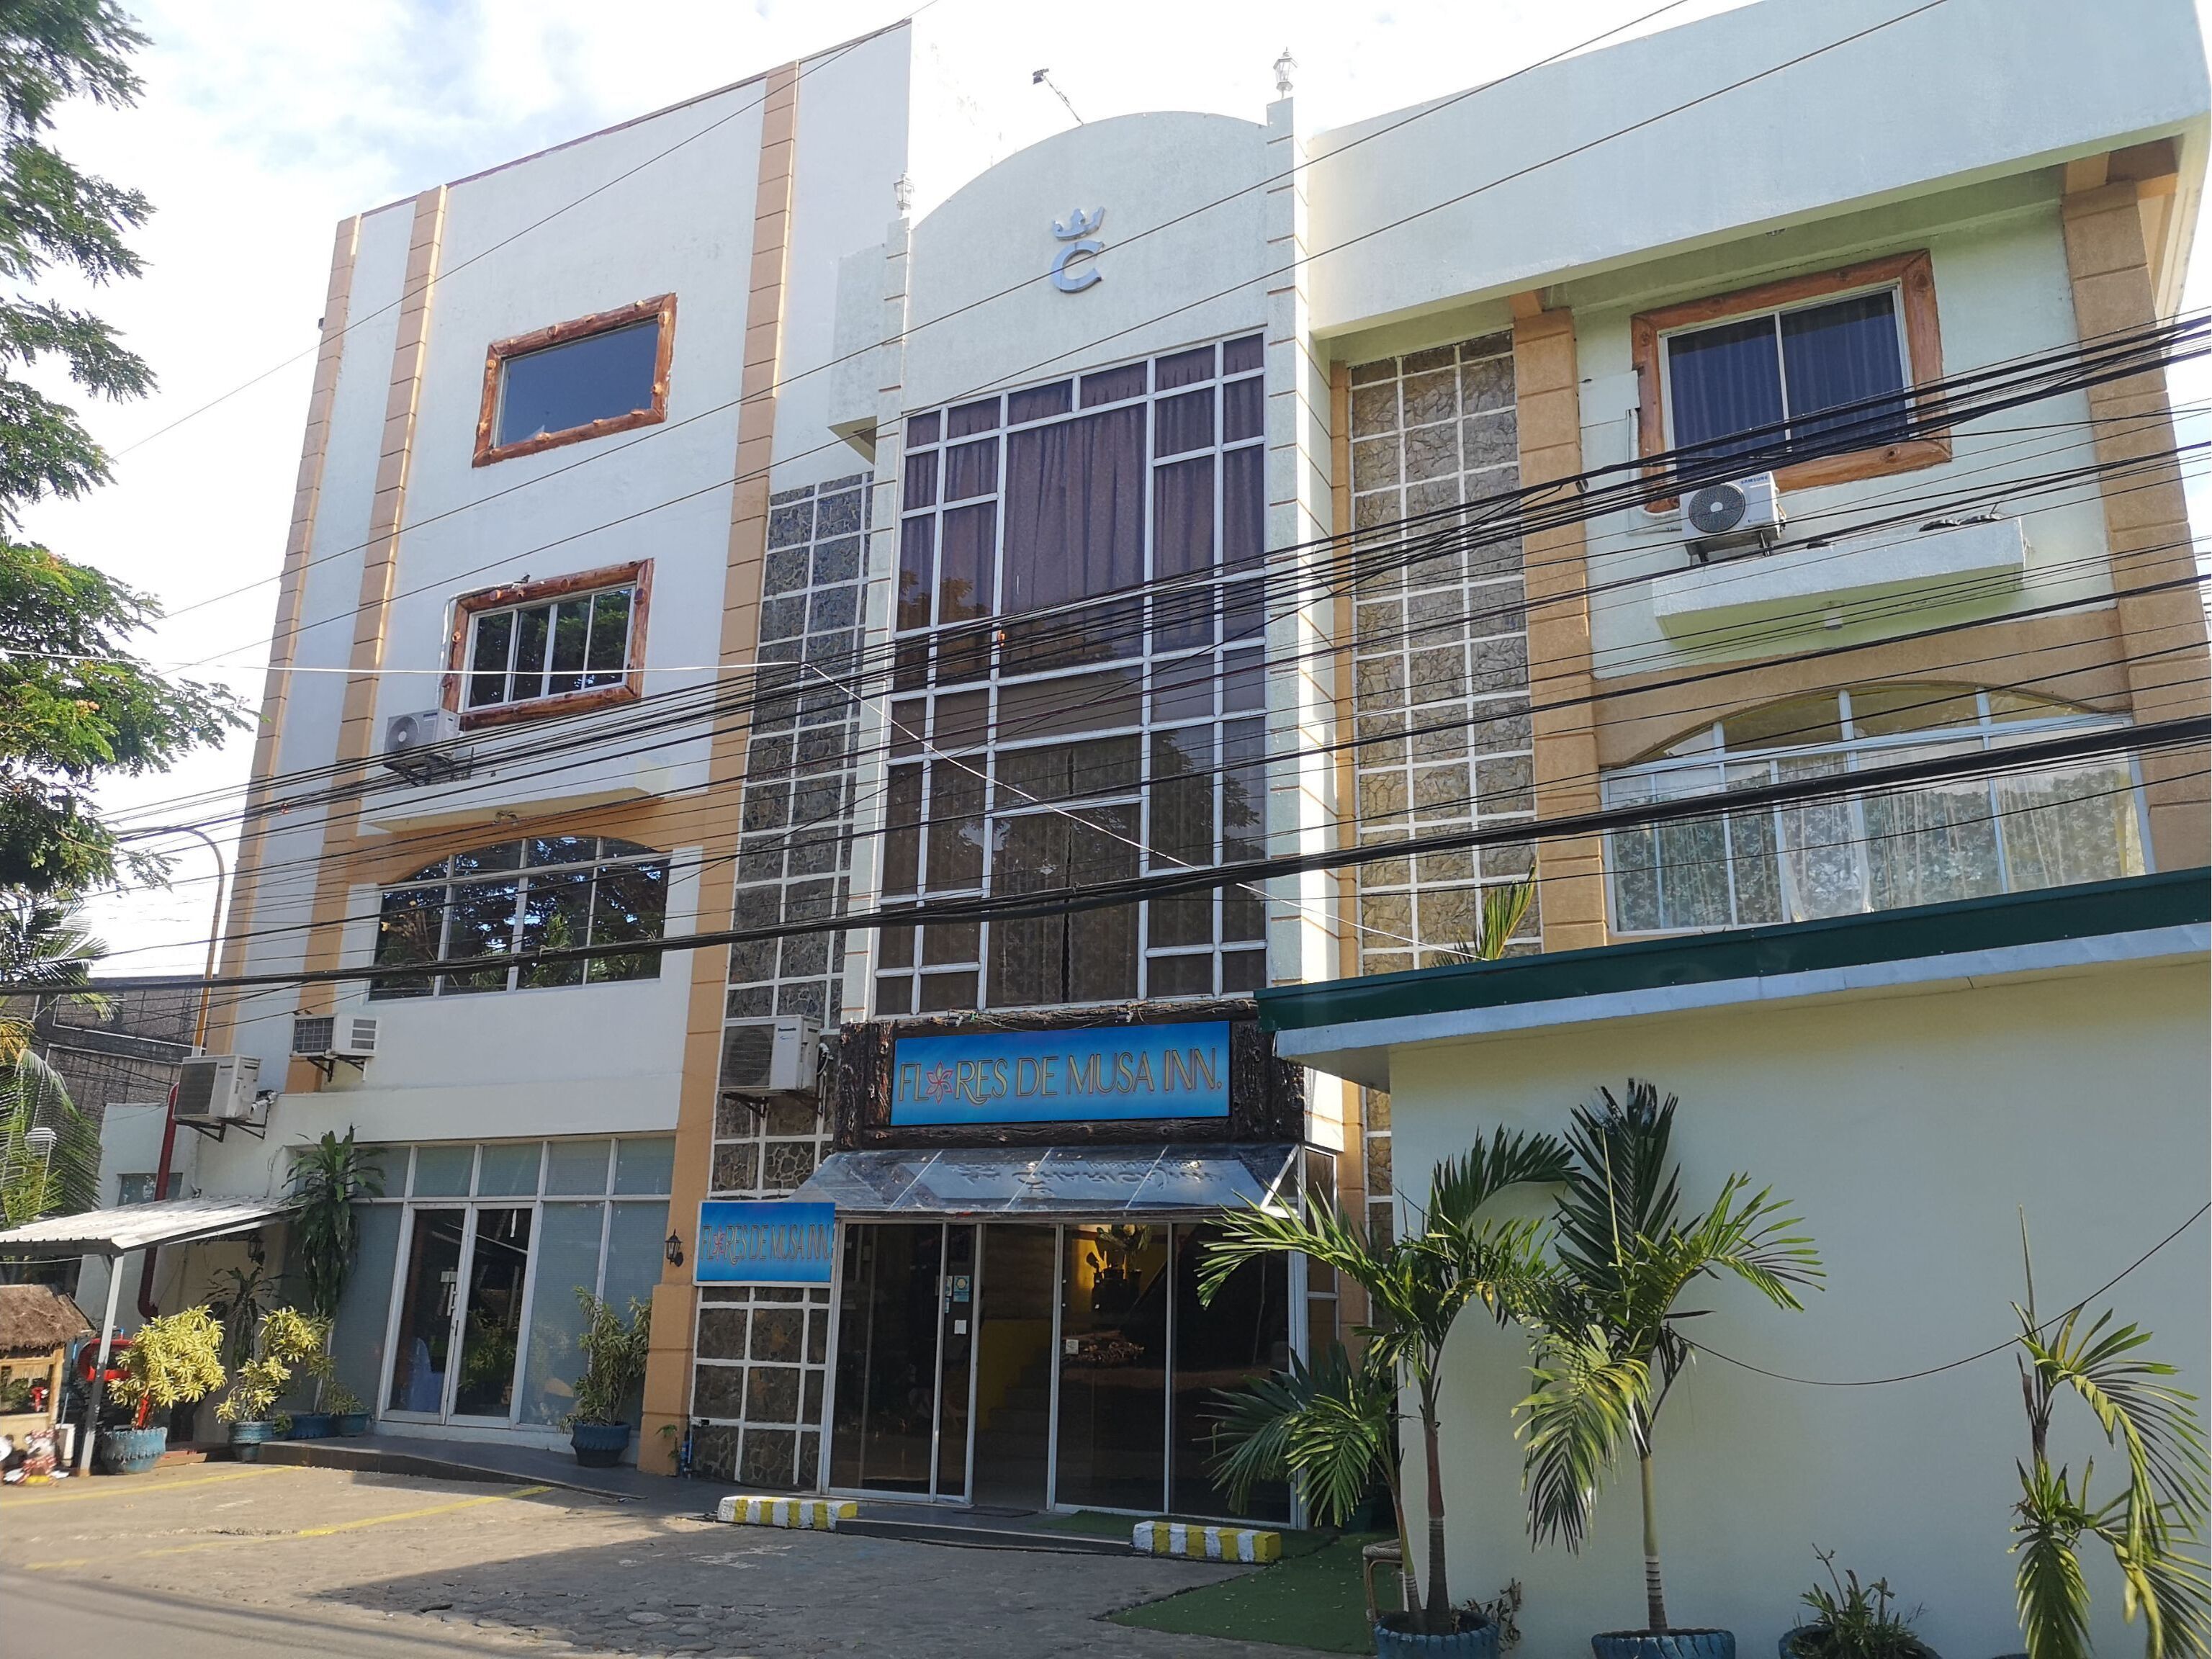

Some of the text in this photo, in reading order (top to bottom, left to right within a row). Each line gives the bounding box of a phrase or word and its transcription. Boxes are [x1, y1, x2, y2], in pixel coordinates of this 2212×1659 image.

[1016, 1056, 1059, 1097] DE
[1067, 1051, 1155, 1095] MUSA
[749, 1225, 768, 1260] DE
[770, 1225, 804, 1259] MUSA
